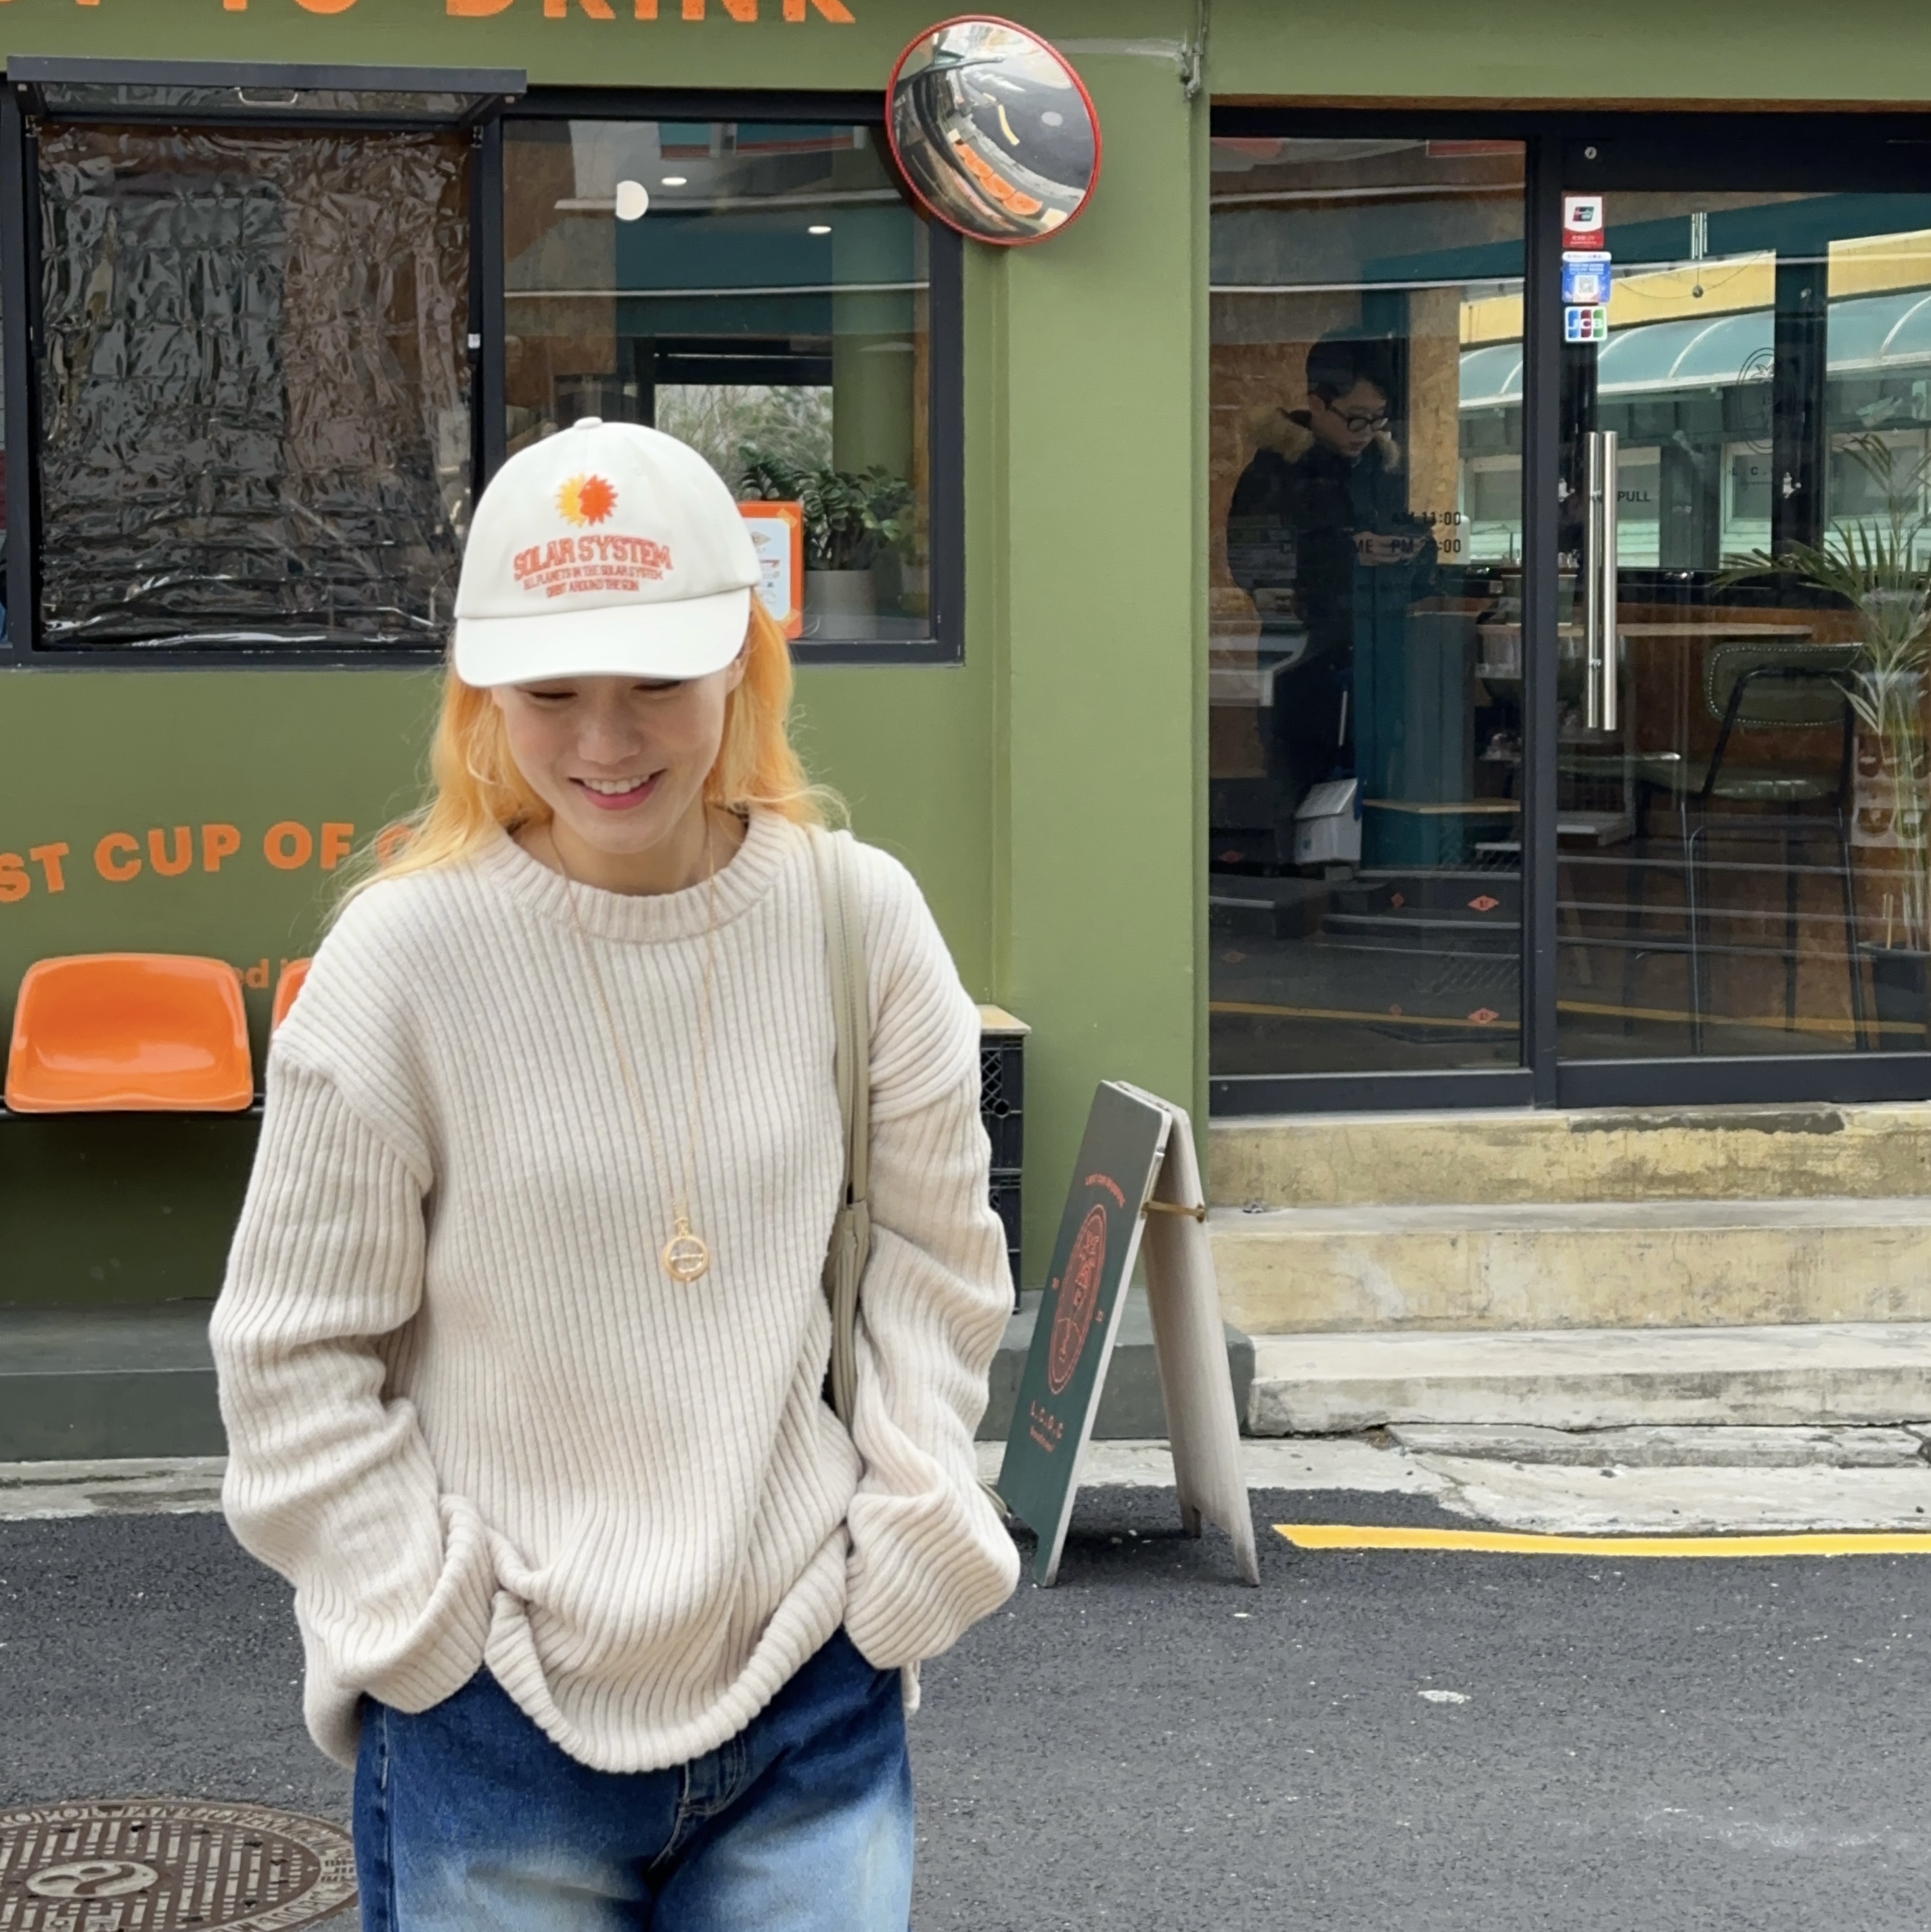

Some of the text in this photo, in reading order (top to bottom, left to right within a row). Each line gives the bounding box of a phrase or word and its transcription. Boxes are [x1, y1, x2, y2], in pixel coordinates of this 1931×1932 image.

[1568, 318, 1604, 329] JCB
[1617, 490, 1651, 502] PULL
[1422, 511, 1461, 526] 11:00
[1391, 539, 1414, 553] PM
[514, 534, 673, 582] SOLAR SYSTEM
[94, 823, 241, 881] CUP
[263, 821, 355, 870] OF
